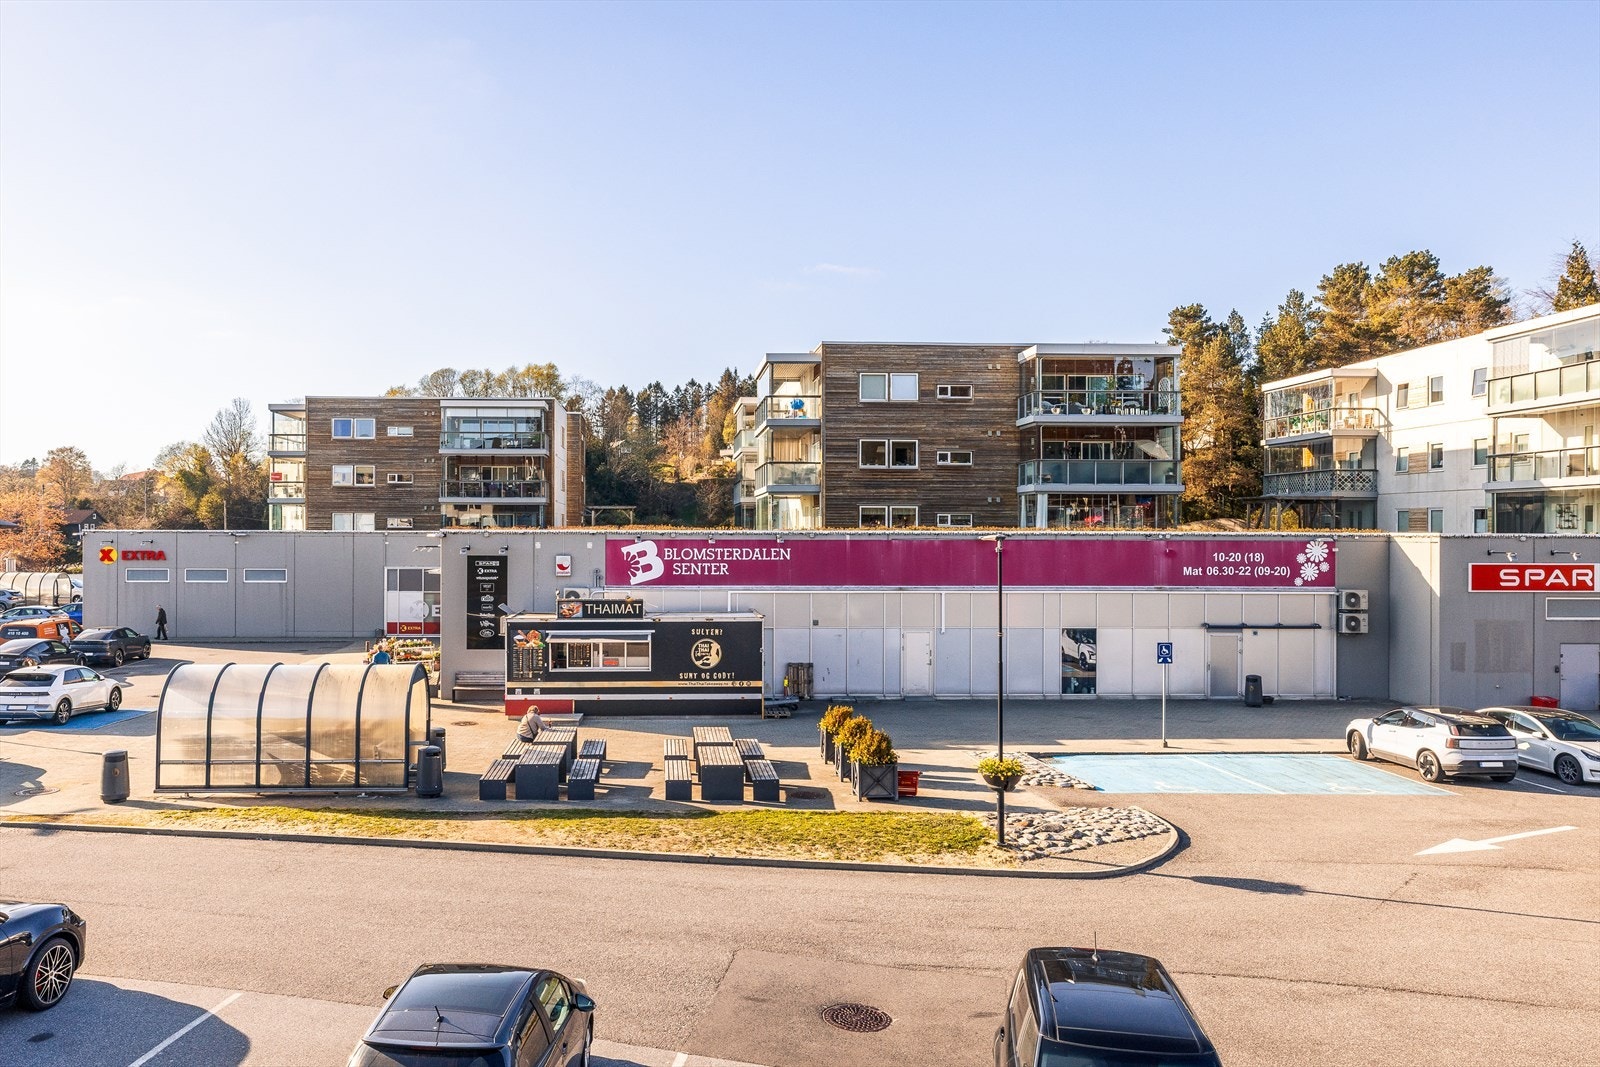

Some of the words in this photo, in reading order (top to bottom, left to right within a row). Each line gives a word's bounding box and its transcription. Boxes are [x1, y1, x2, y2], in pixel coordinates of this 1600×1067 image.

[121, 550, 167, 561] EXTRA
[663, 548, 791, 561] BLOMSTERDALEN
[1212, 552, 1242, 562] 10-20
[1244, 552, 1265, 564] (18)
[672, 562, 730, 576] SENTER
[1182, 566, 1203, 576] Mat
[1206, 566, 1252, 576] 06.30-22
[1254, 566, 1291, 578] (09-20)
[1499, 568, 1594, 587] SPAR
[585, 603, 641, 615] THAIMAT
